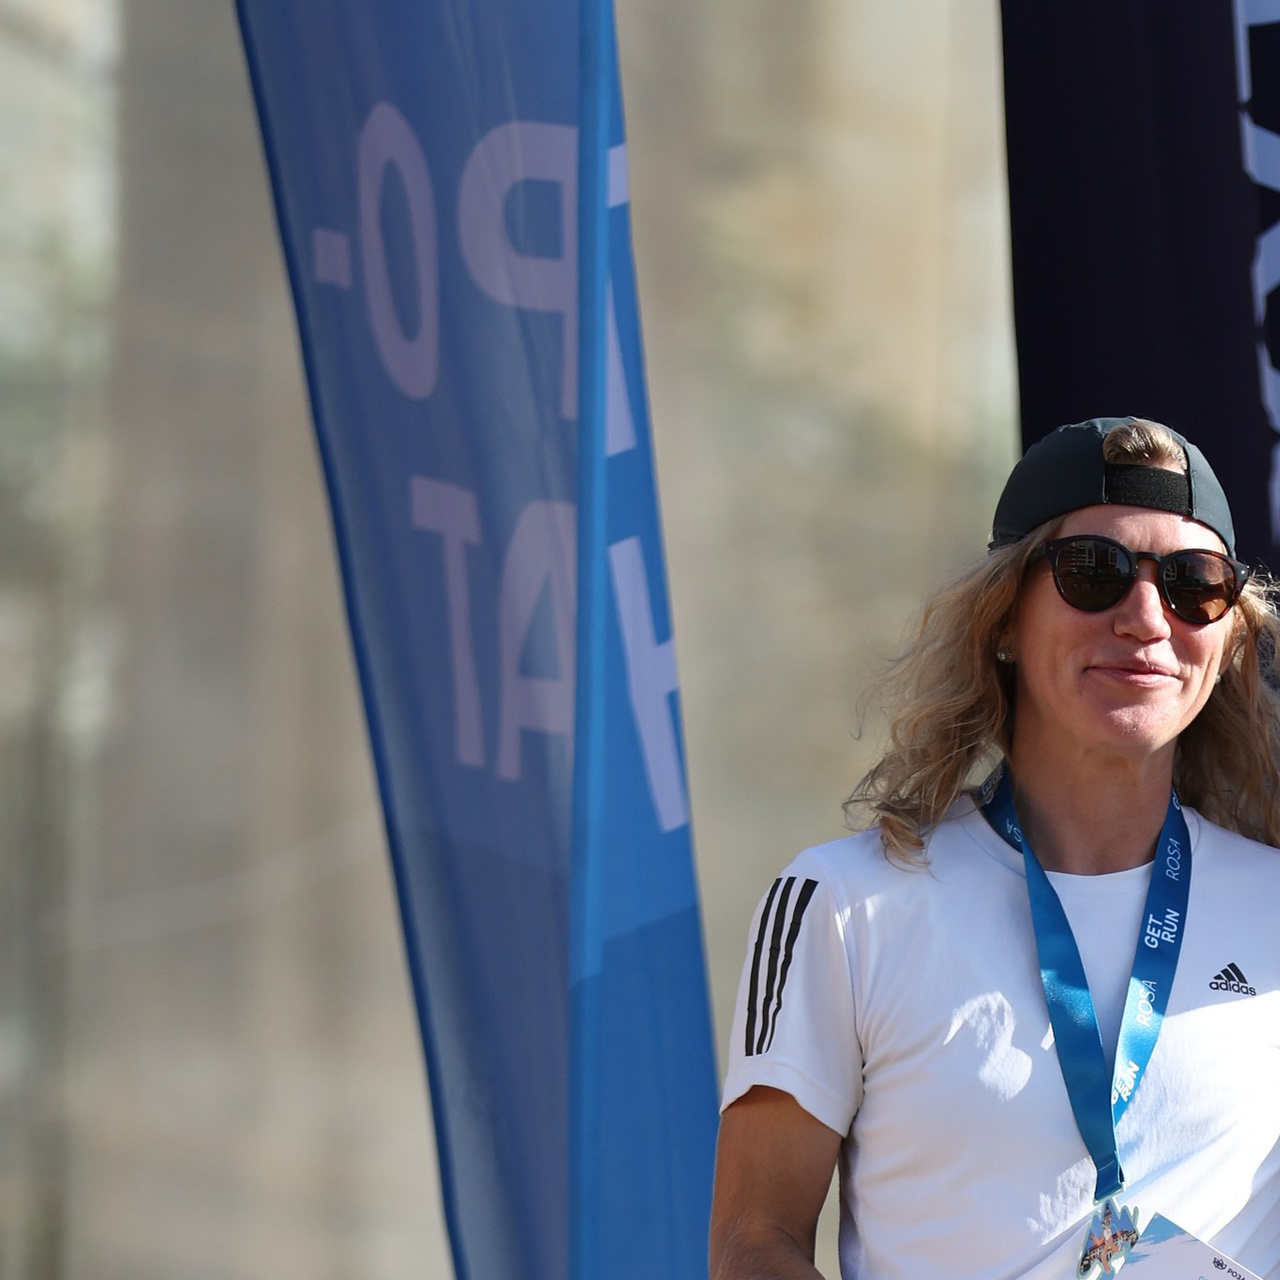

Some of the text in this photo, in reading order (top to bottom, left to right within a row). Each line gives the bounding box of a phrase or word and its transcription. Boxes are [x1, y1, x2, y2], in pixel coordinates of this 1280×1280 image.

[1165, 837, 1181, 881] ROSA
[1144, 914, 1164, 949] GET
[1160, 908, 1181, 944] RUN
[1136, 980, 1158, 1027] ROSA
[1209, 980, 1257, 996] adidas
